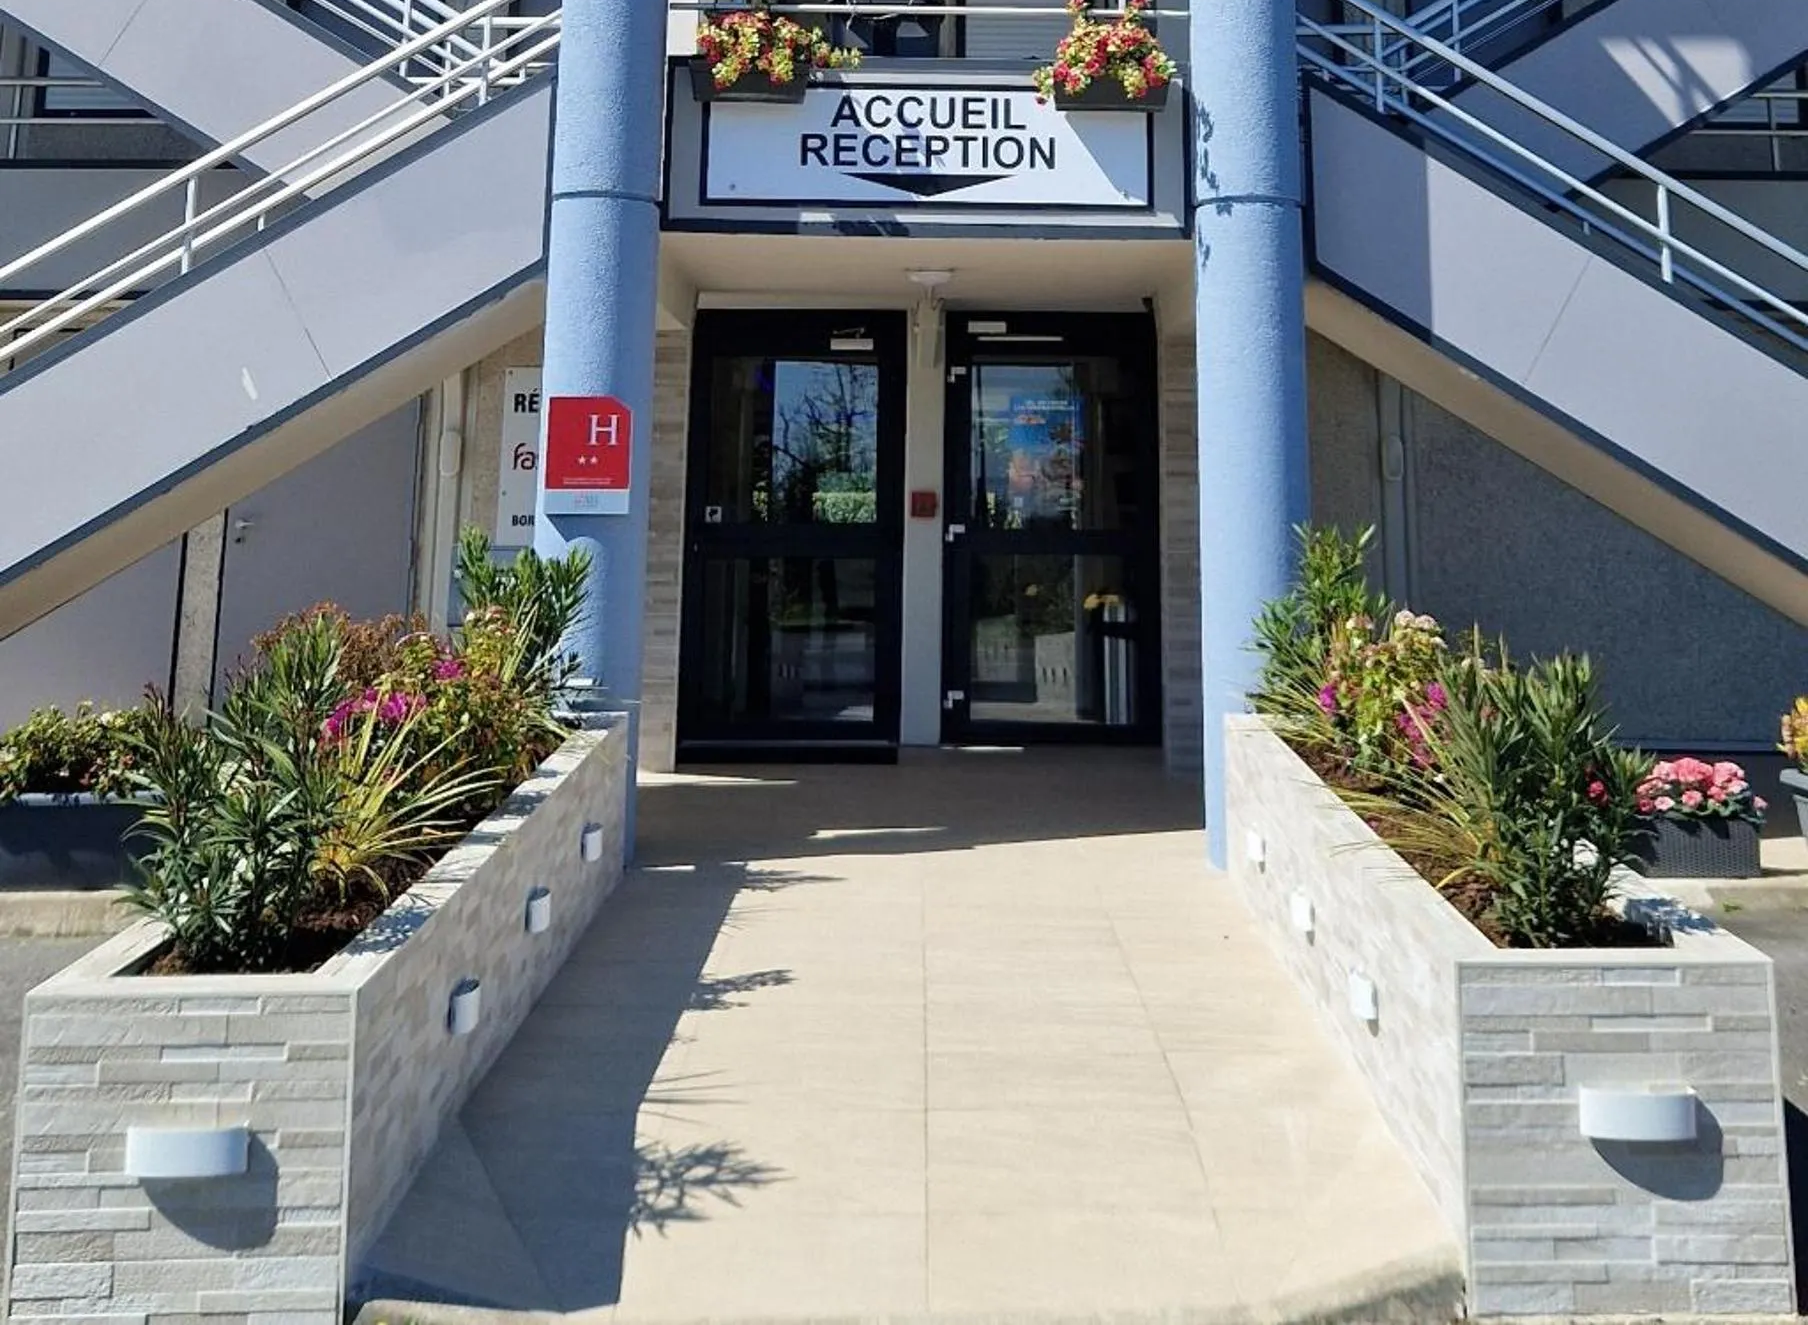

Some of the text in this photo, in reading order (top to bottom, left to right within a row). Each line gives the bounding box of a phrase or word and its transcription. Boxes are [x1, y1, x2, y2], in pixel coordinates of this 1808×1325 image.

[830, 95, 1027, 130] ACCUEIL
[799, 133, 1056, 170] RECEPTION
[587, 414, 621, 446] H
